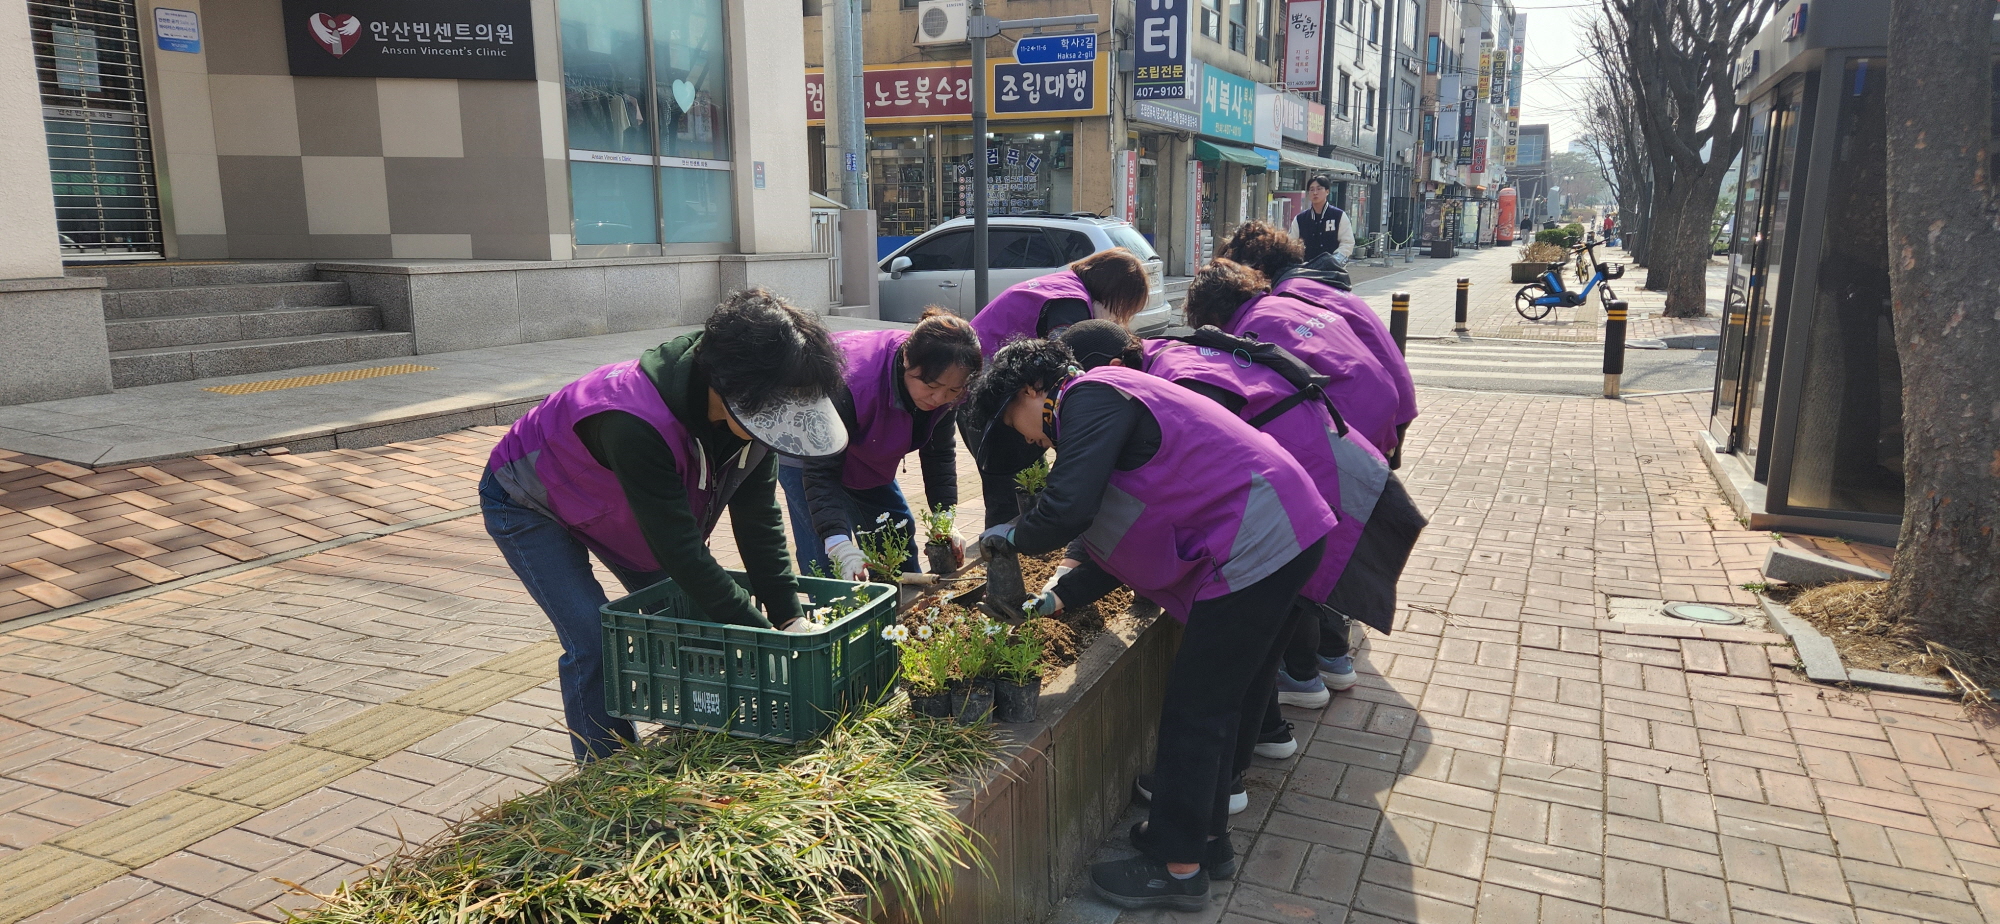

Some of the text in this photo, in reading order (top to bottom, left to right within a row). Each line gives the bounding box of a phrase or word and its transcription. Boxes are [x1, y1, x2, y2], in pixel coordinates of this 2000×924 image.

[370, 21, 514, 45] 안산빈센트의원
[1144, 0, 1178, 58] 터
[1060, 36, 1094, 50] 학사2길
[381, 46, 507, 57] Ansan Vincent's Clinic
[1057, 50, 1094, 60] Haksa 2-gil
[1136, 64, 1184, 79] 조립전문
[1001, 68, 1087, 104] 조립대행
[1136, 86, 1184, 97] 407-9103
[1205, 75, 1243, 120] 세복사
[1325, 219, 1336, 232] H
